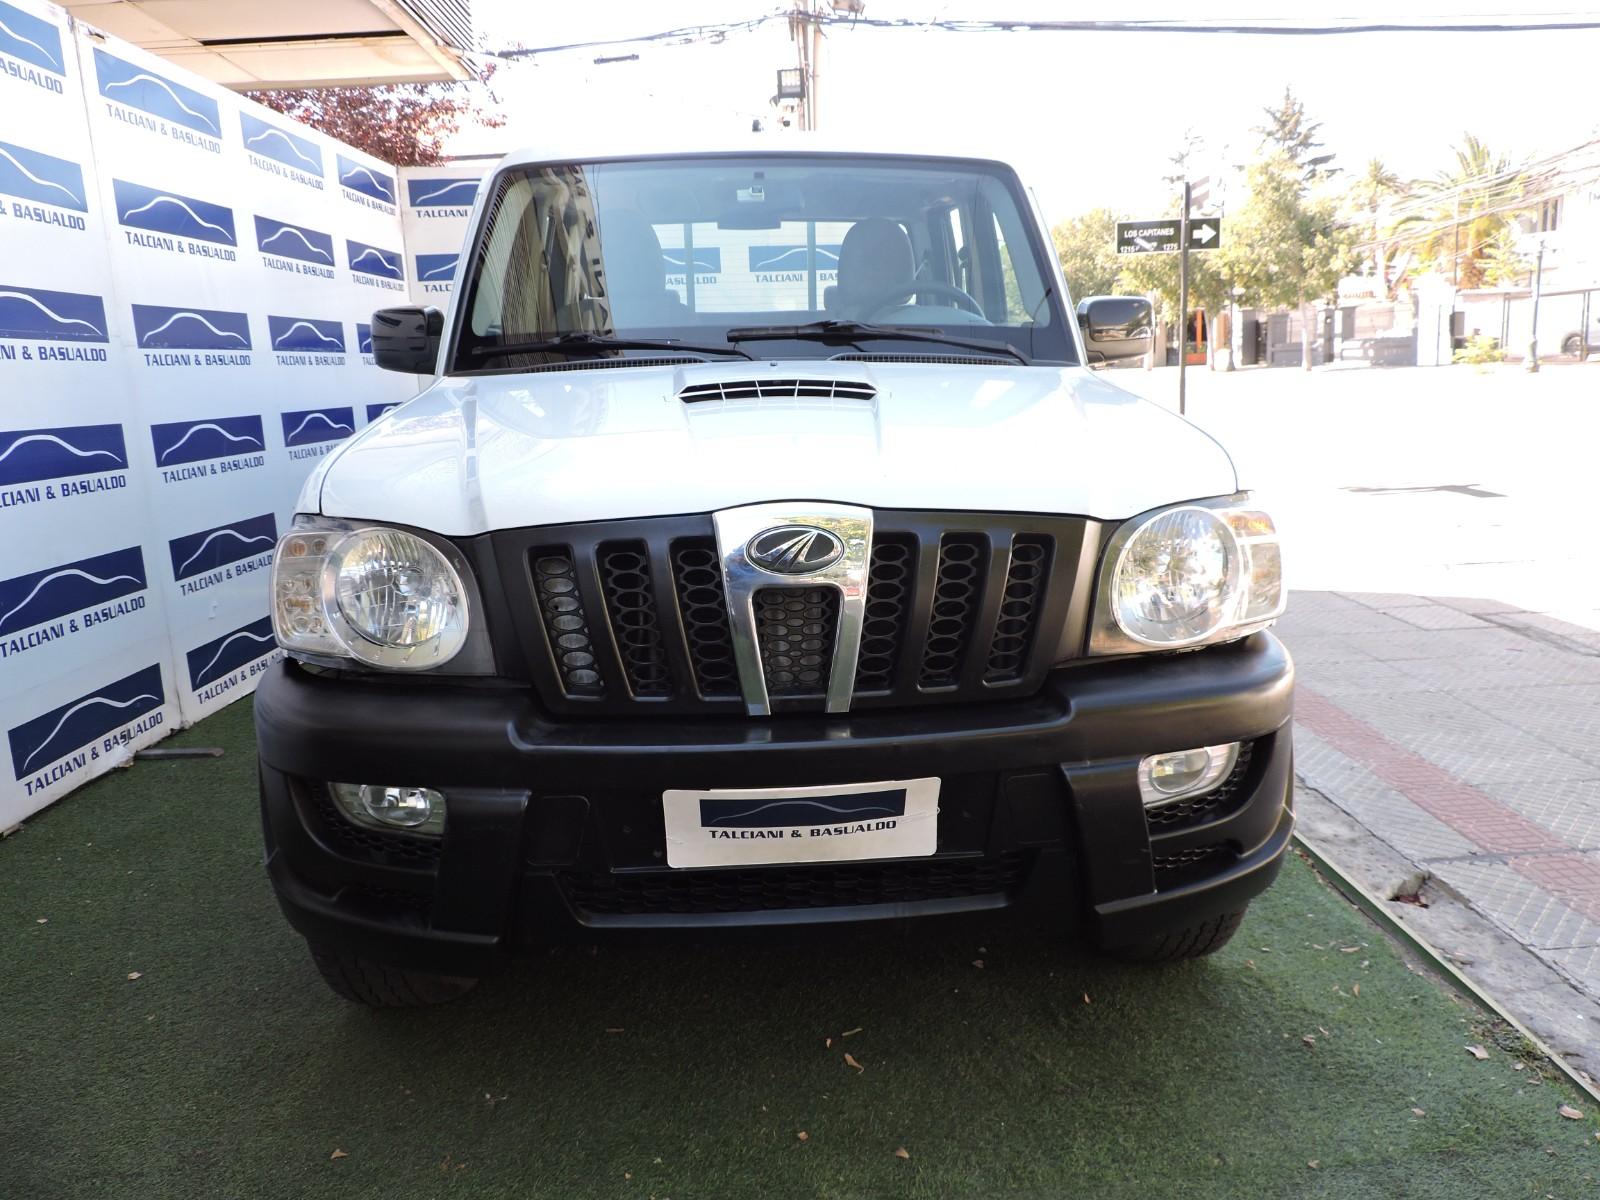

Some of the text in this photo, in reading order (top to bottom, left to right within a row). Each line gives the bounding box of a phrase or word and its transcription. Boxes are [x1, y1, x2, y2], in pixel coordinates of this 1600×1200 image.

[106, 103, 221, 155] TALCIANI & BASUALDO
[248, 155, 323, 190] TALCIANI & BASUALDO
[342, 190, 395, 216] TALCIANI & BASUALDO
[416, 209, 468, 218] TALCIANI
[12, 202, 86, 231] BASUALDO
[1124, 228, 1175, 238] LOS CAPITANES
[125, 231, 236, 262] TALCIANI & BASUALDO
[263, 257, 334, 279] TALCIANI & BASUALDO
[755, 273, 803, 283] TALCIANI
[352, 274, 404, 291] TALCIANI & BASUALDO
[22, 346, 33, 360] &
[38, 346, 107, 362] BASUALDO
[144, 353, 251, 366] TALCIANI & BASUALDO
[277, 355, 345, 366] TALCIANI & BASUALDO
[289, 447, 318, 461] TALCIANI
[319, 445, 325, 456] &
[162, 455, 264, 484] TALCIANI & BASUALDO
[46, 485, 56, 499] &
[62, 475, 126, 498] BASUALDO
[180, 570, 223, 596] TALCIANI
[225, 568, 233, 580] &
[0, 596, 146, 657] TALCIANI & BASUALDO
[198, 675, 237, 704] TALCIANI
[240, 670, 248, 682] &
[25, 711, 163, 797] TALCIANI & BASUALDO
[709, 820, 897, 839] TALCIANI & BASUALDO
